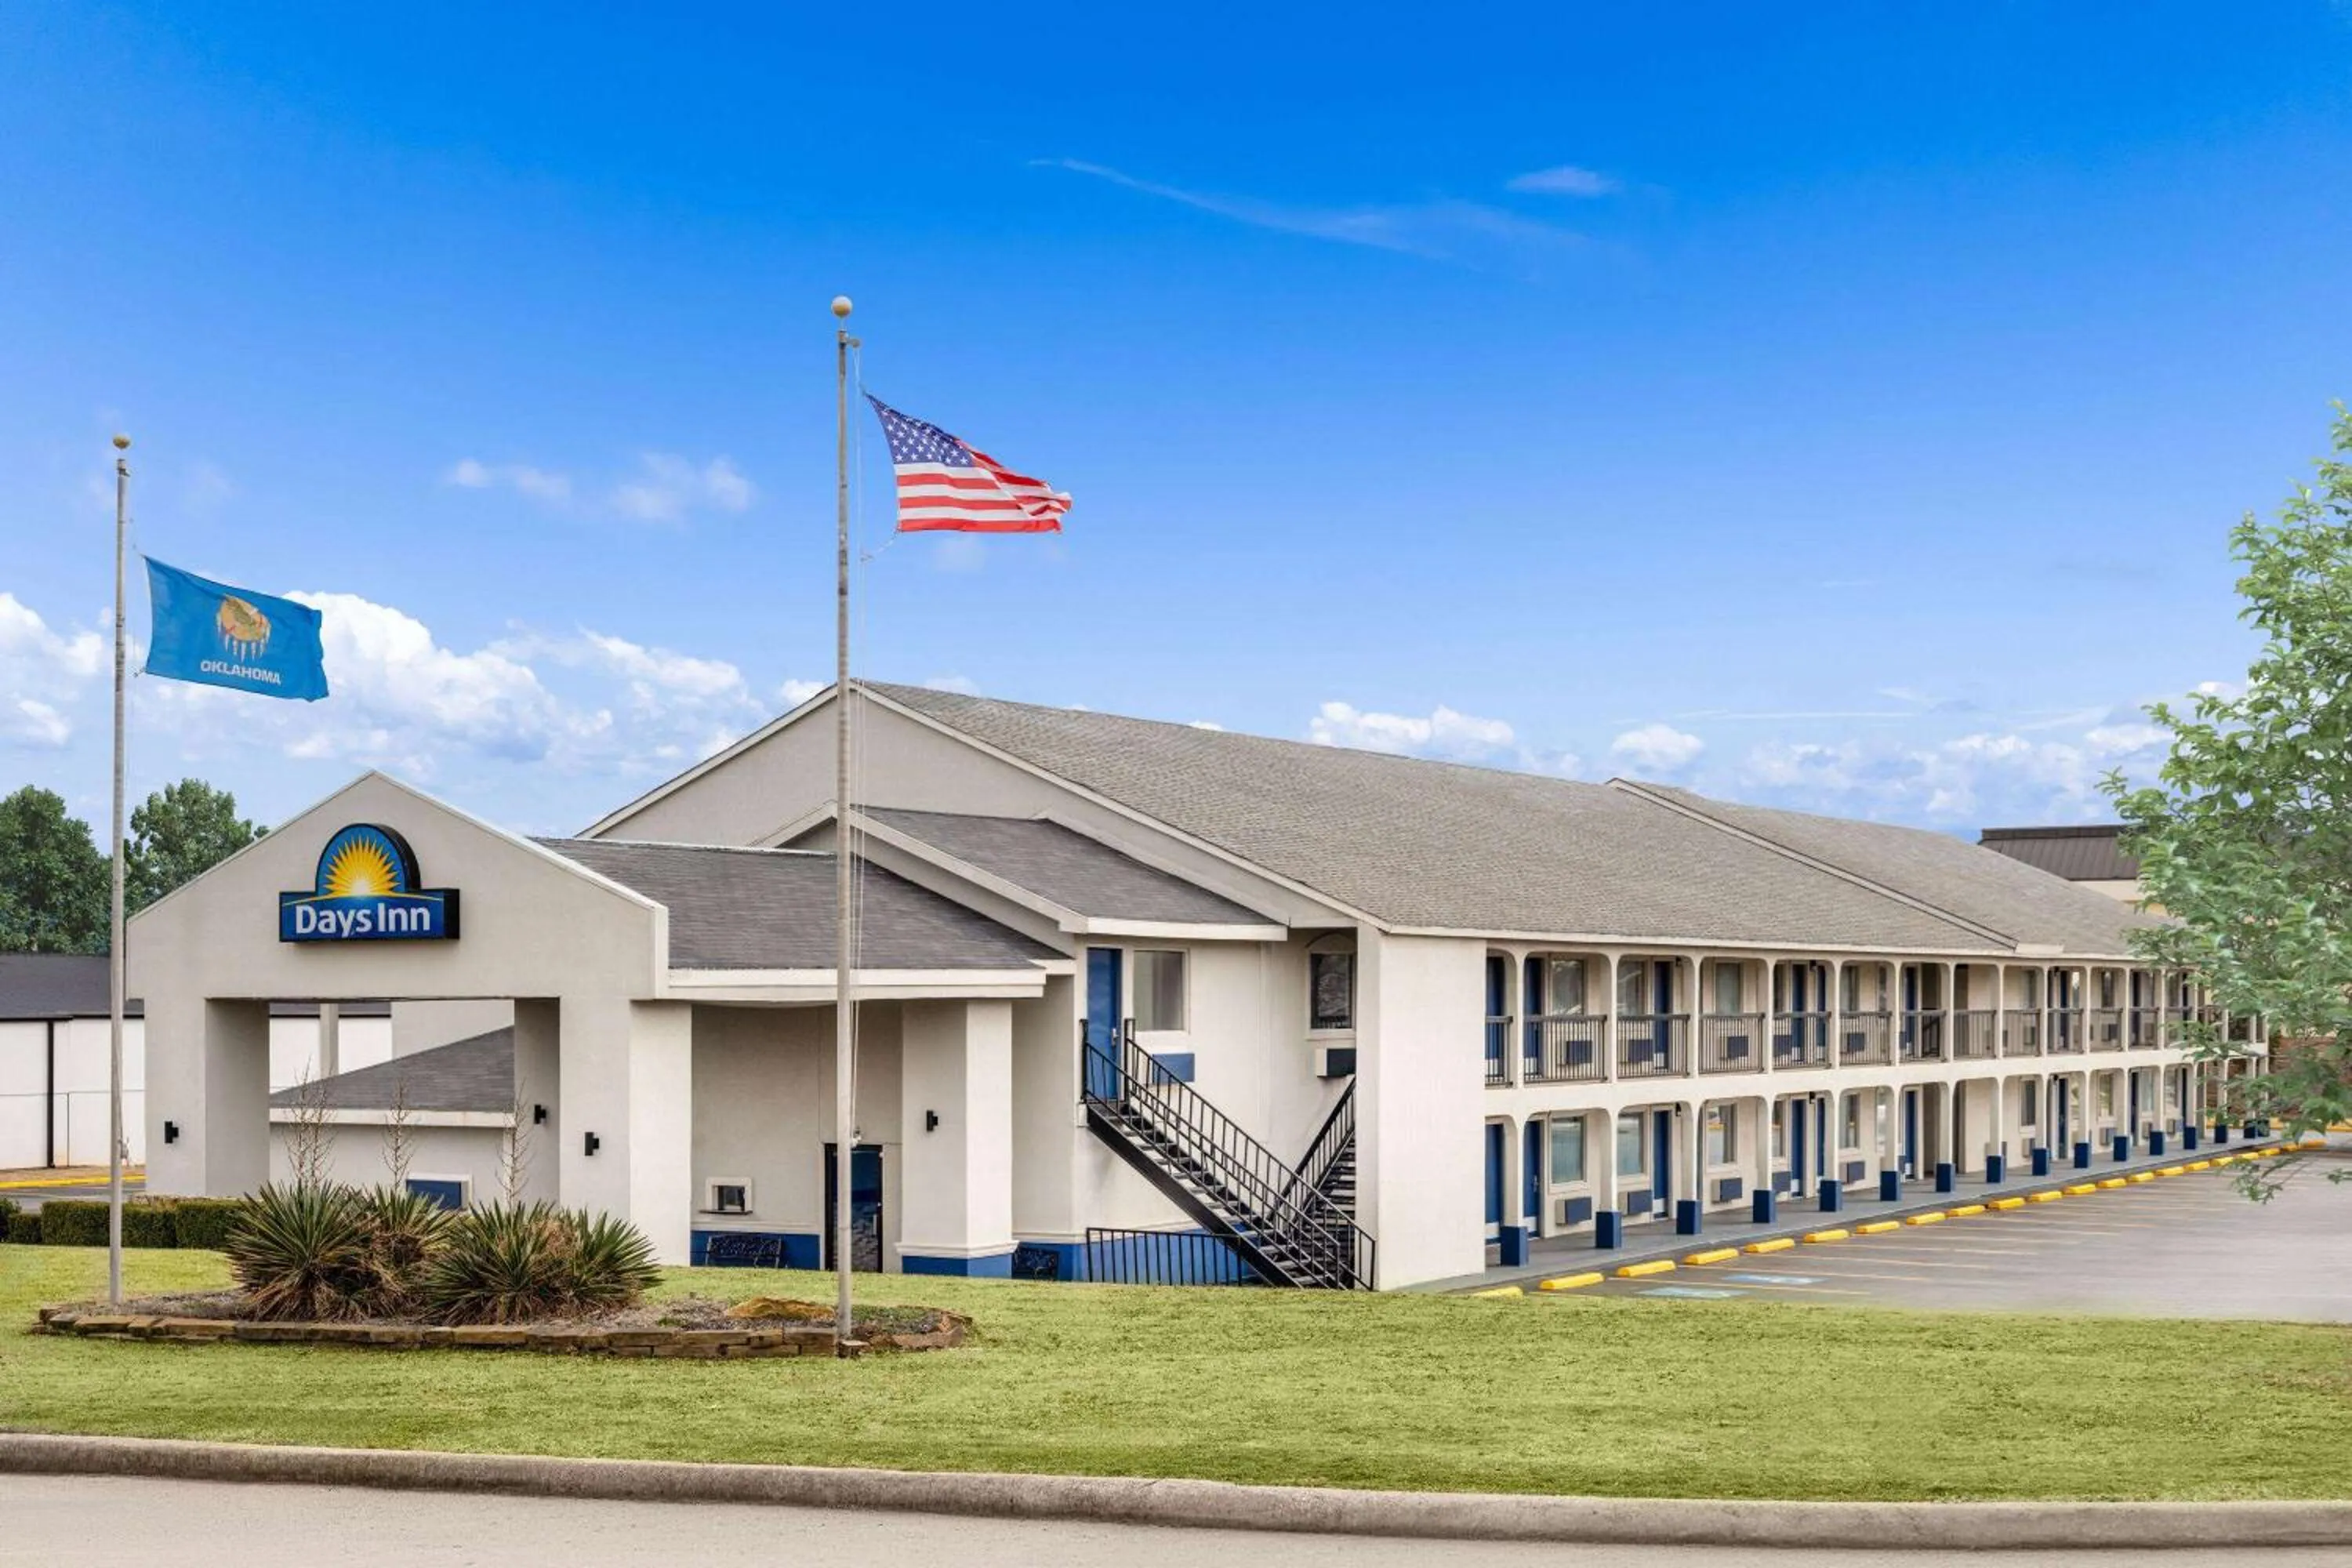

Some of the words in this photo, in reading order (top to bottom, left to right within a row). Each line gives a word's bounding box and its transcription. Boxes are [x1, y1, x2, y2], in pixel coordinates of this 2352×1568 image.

[200, 660, 281, 685] OKLAHOMA
[295, 905, 372, 938] Days
[378, 902, 430, 932] Inn
